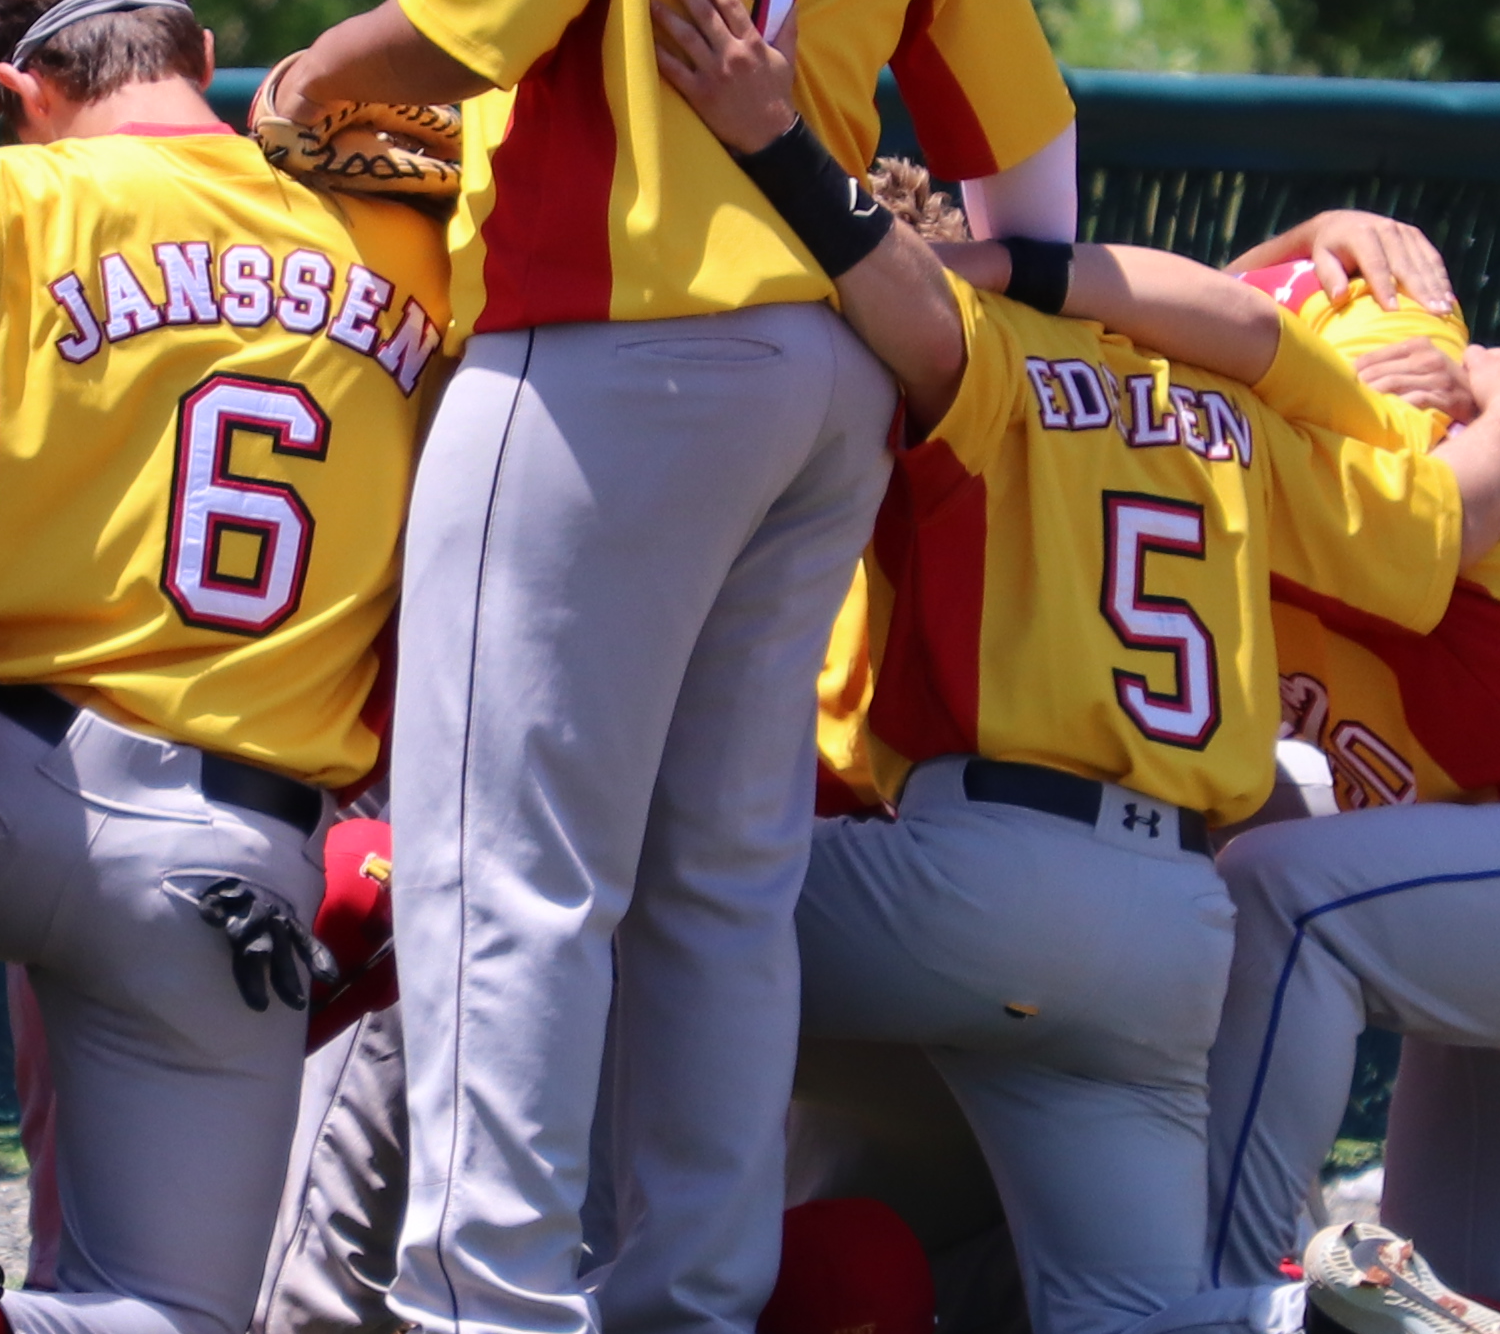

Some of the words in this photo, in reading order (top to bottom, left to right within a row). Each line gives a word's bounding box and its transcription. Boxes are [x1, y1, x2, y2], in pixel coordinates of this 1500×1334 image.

[47, 241, 442, 398] JANSSEN
[159, 370, 331, 638] 6
[1098, 489, 1221, 752] 5
